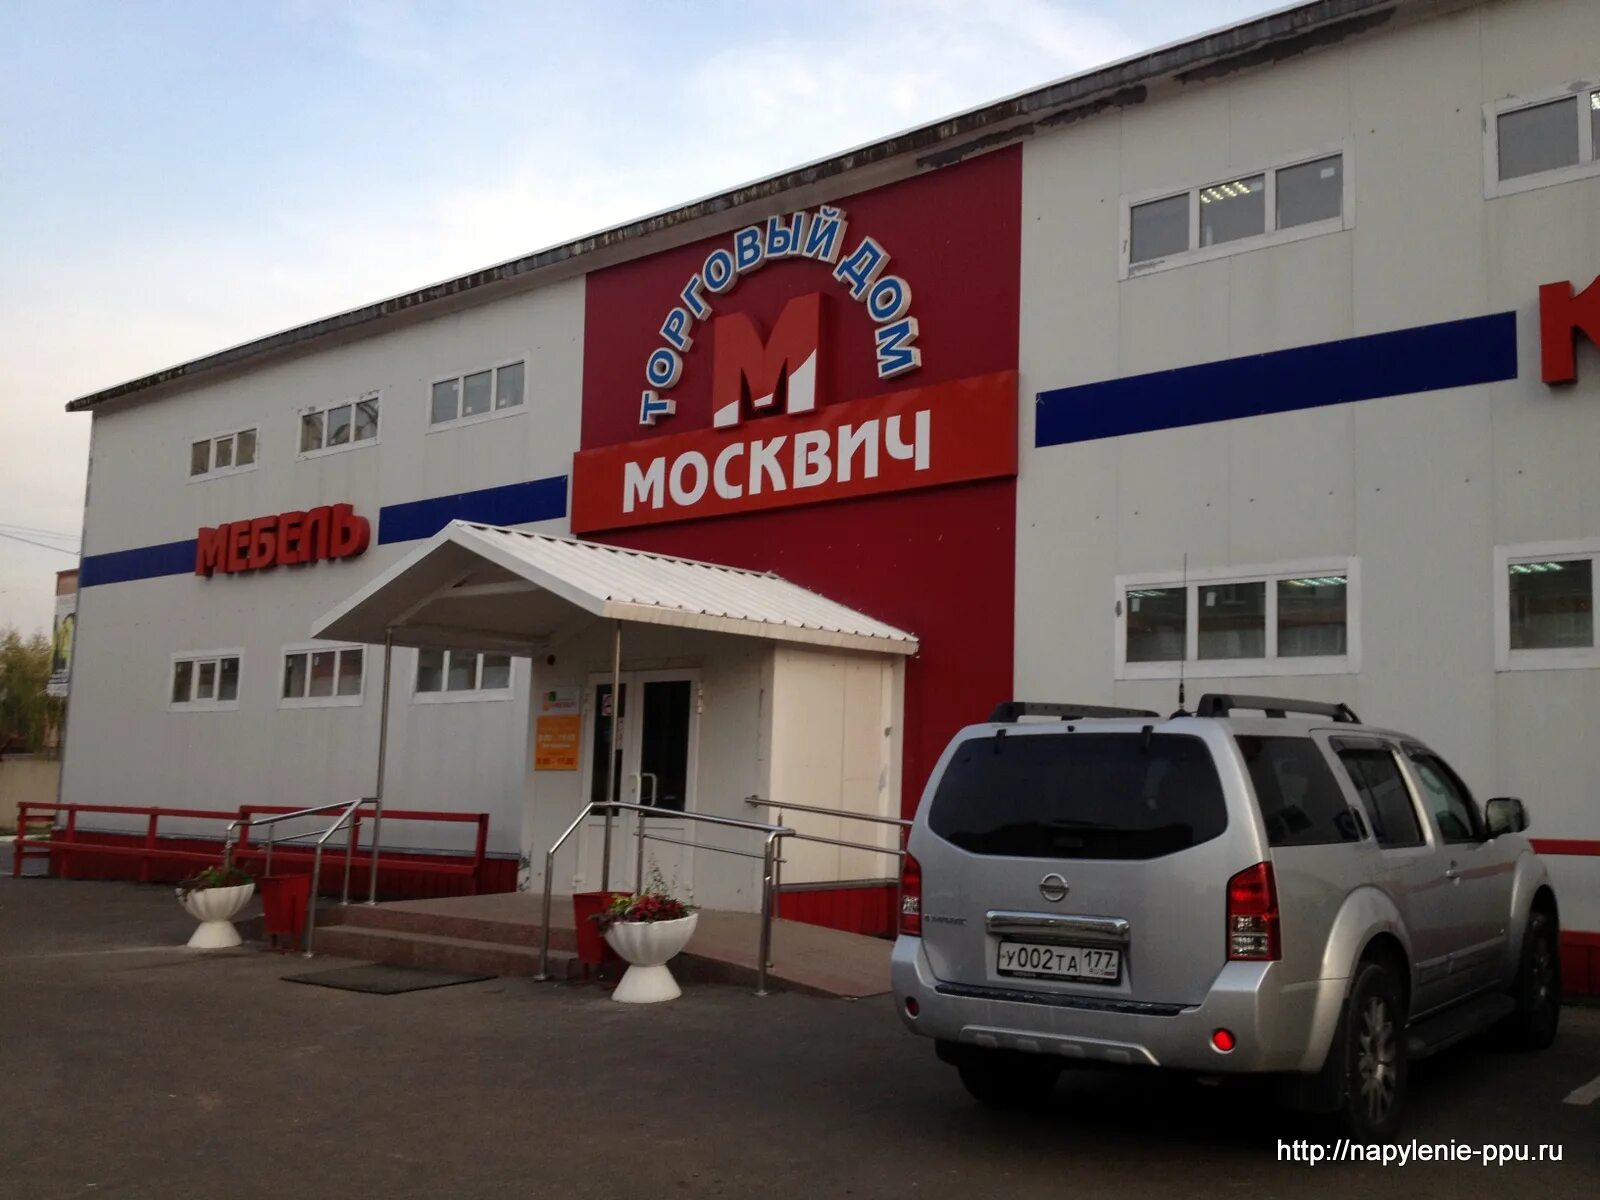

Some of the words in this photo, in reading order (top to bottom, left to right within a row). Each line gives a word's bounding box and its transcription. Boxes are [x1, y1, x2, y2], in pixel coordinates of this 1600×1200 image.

[639, 205, 848, 425] ТОРГОВЫЙ
[832, 235, 922, 379] ДОМ
[622, 409, 931, 513] МОСКВИЧ
[195, 502, 370, 577] МЕБЕЛЬ
[1084, 950, 1114, 969] 177
